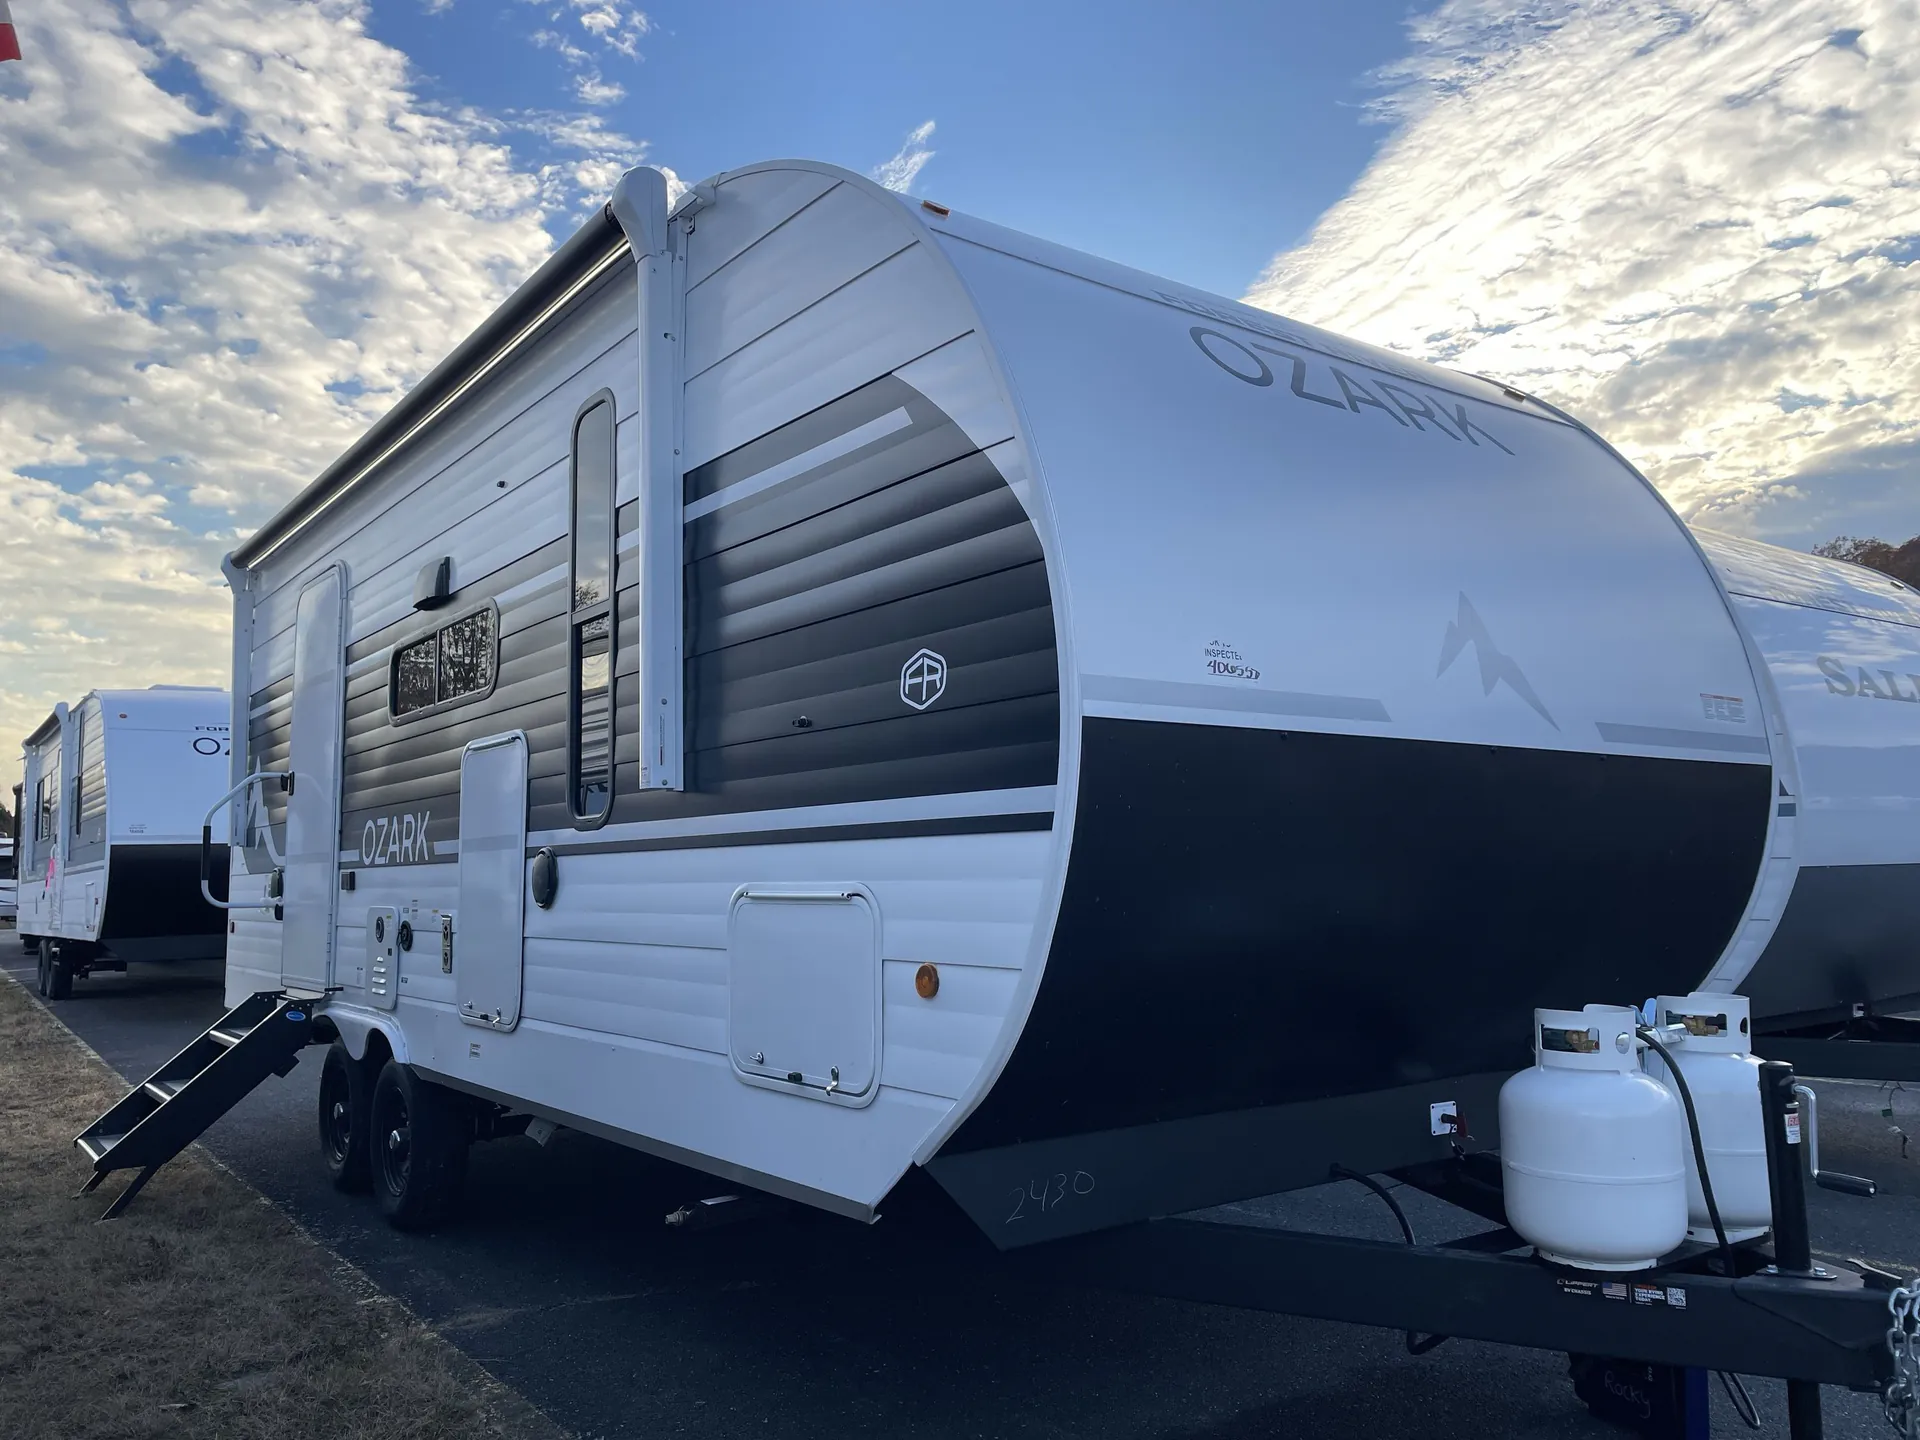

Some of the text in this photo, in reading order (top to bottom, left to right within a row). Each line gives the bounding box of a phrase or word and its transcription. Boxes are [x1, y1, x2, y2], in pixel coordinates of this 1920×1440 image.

[1189, 326, 1516, 456] OZARK
[362, 810, 430, 866] OZARK
[1005, 1170, 1095, 1224] 2430
